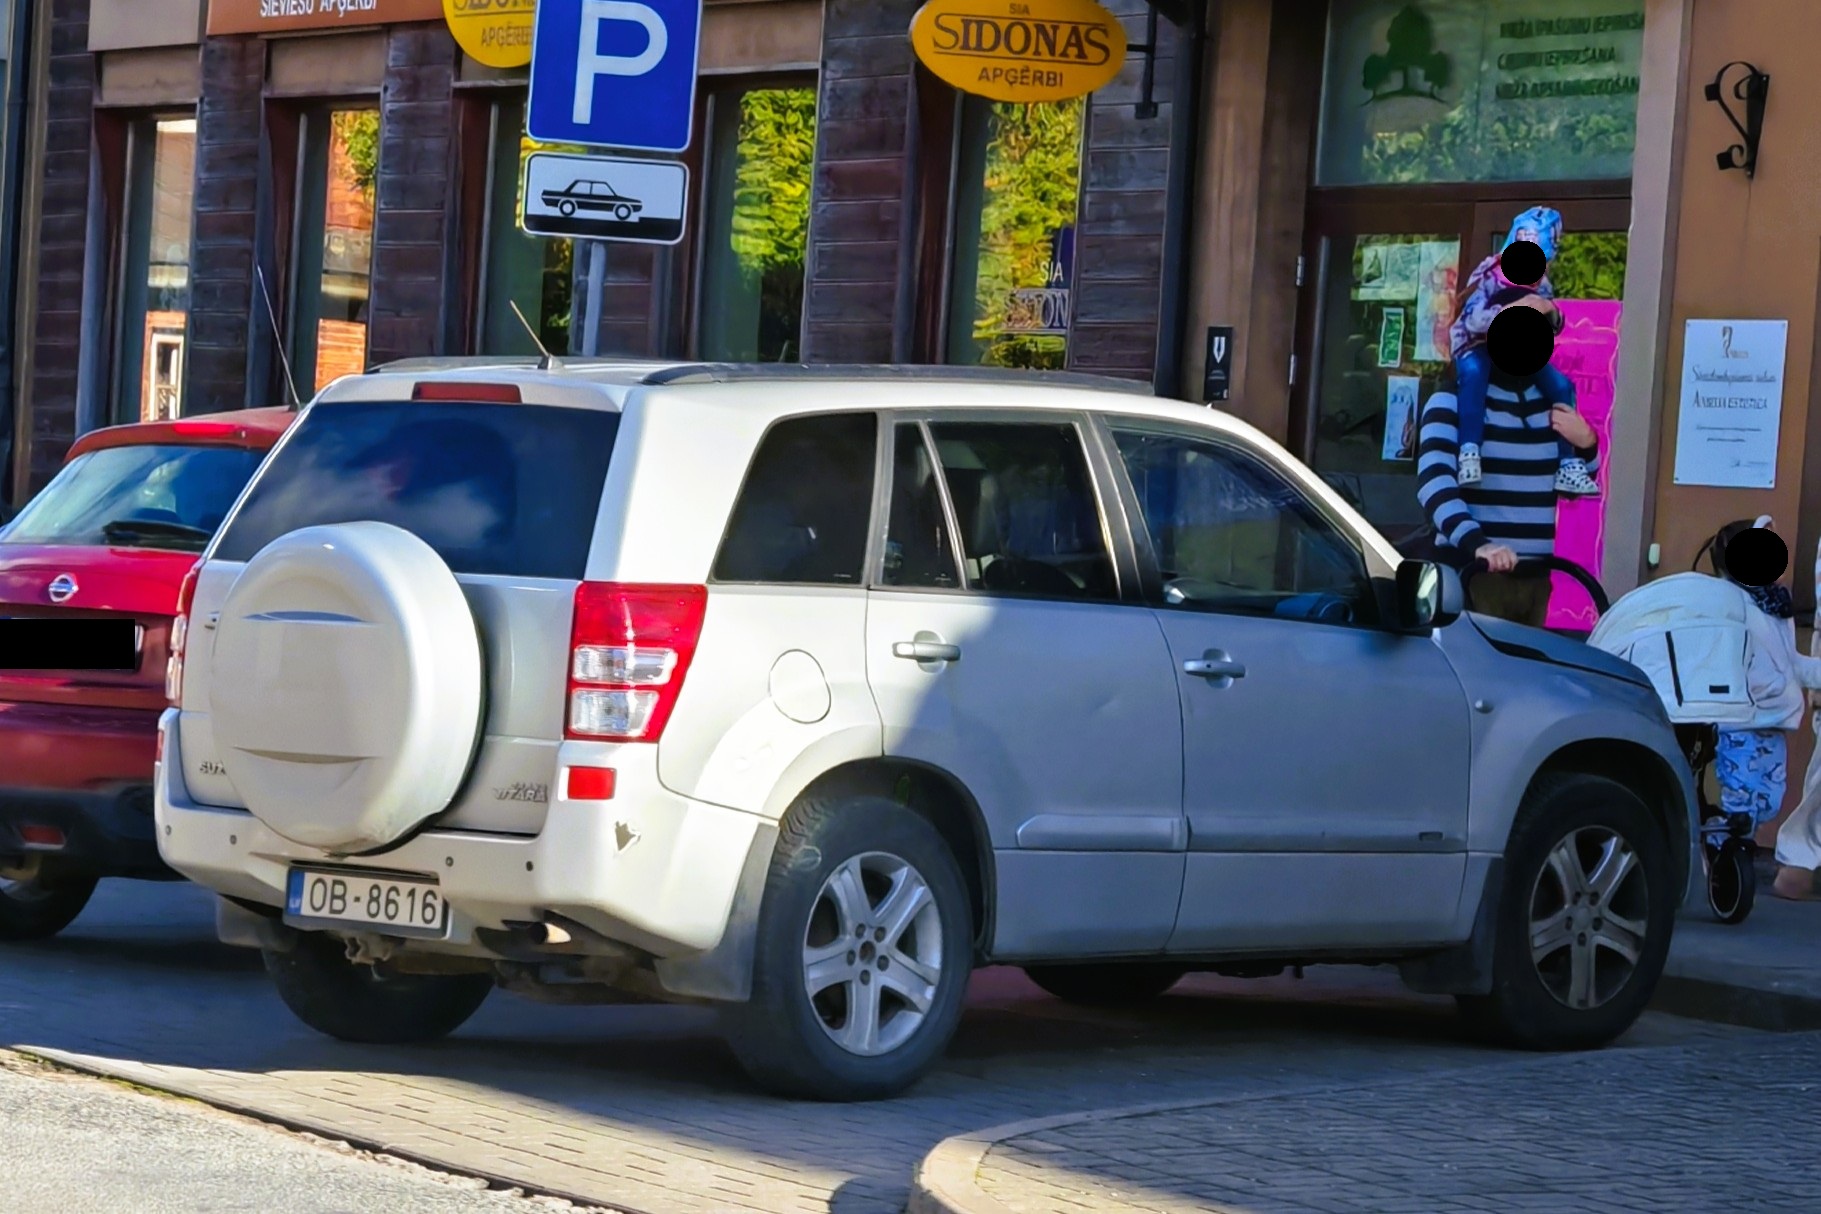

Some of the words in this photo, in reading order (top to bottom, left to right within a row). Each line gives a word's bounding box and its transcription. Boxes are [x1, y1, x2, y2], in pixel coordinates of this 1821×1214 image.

[1008, 3, 1030, 16] SIA
[932, 12, 1111, 66] SIDONAS
[572, 0, 668, 125] P
[978, 66, 1064, 88] APĢĒRBI
[1040, 260, 1064, 283] SIA
[309, 877, 438, 925] OB-8616
